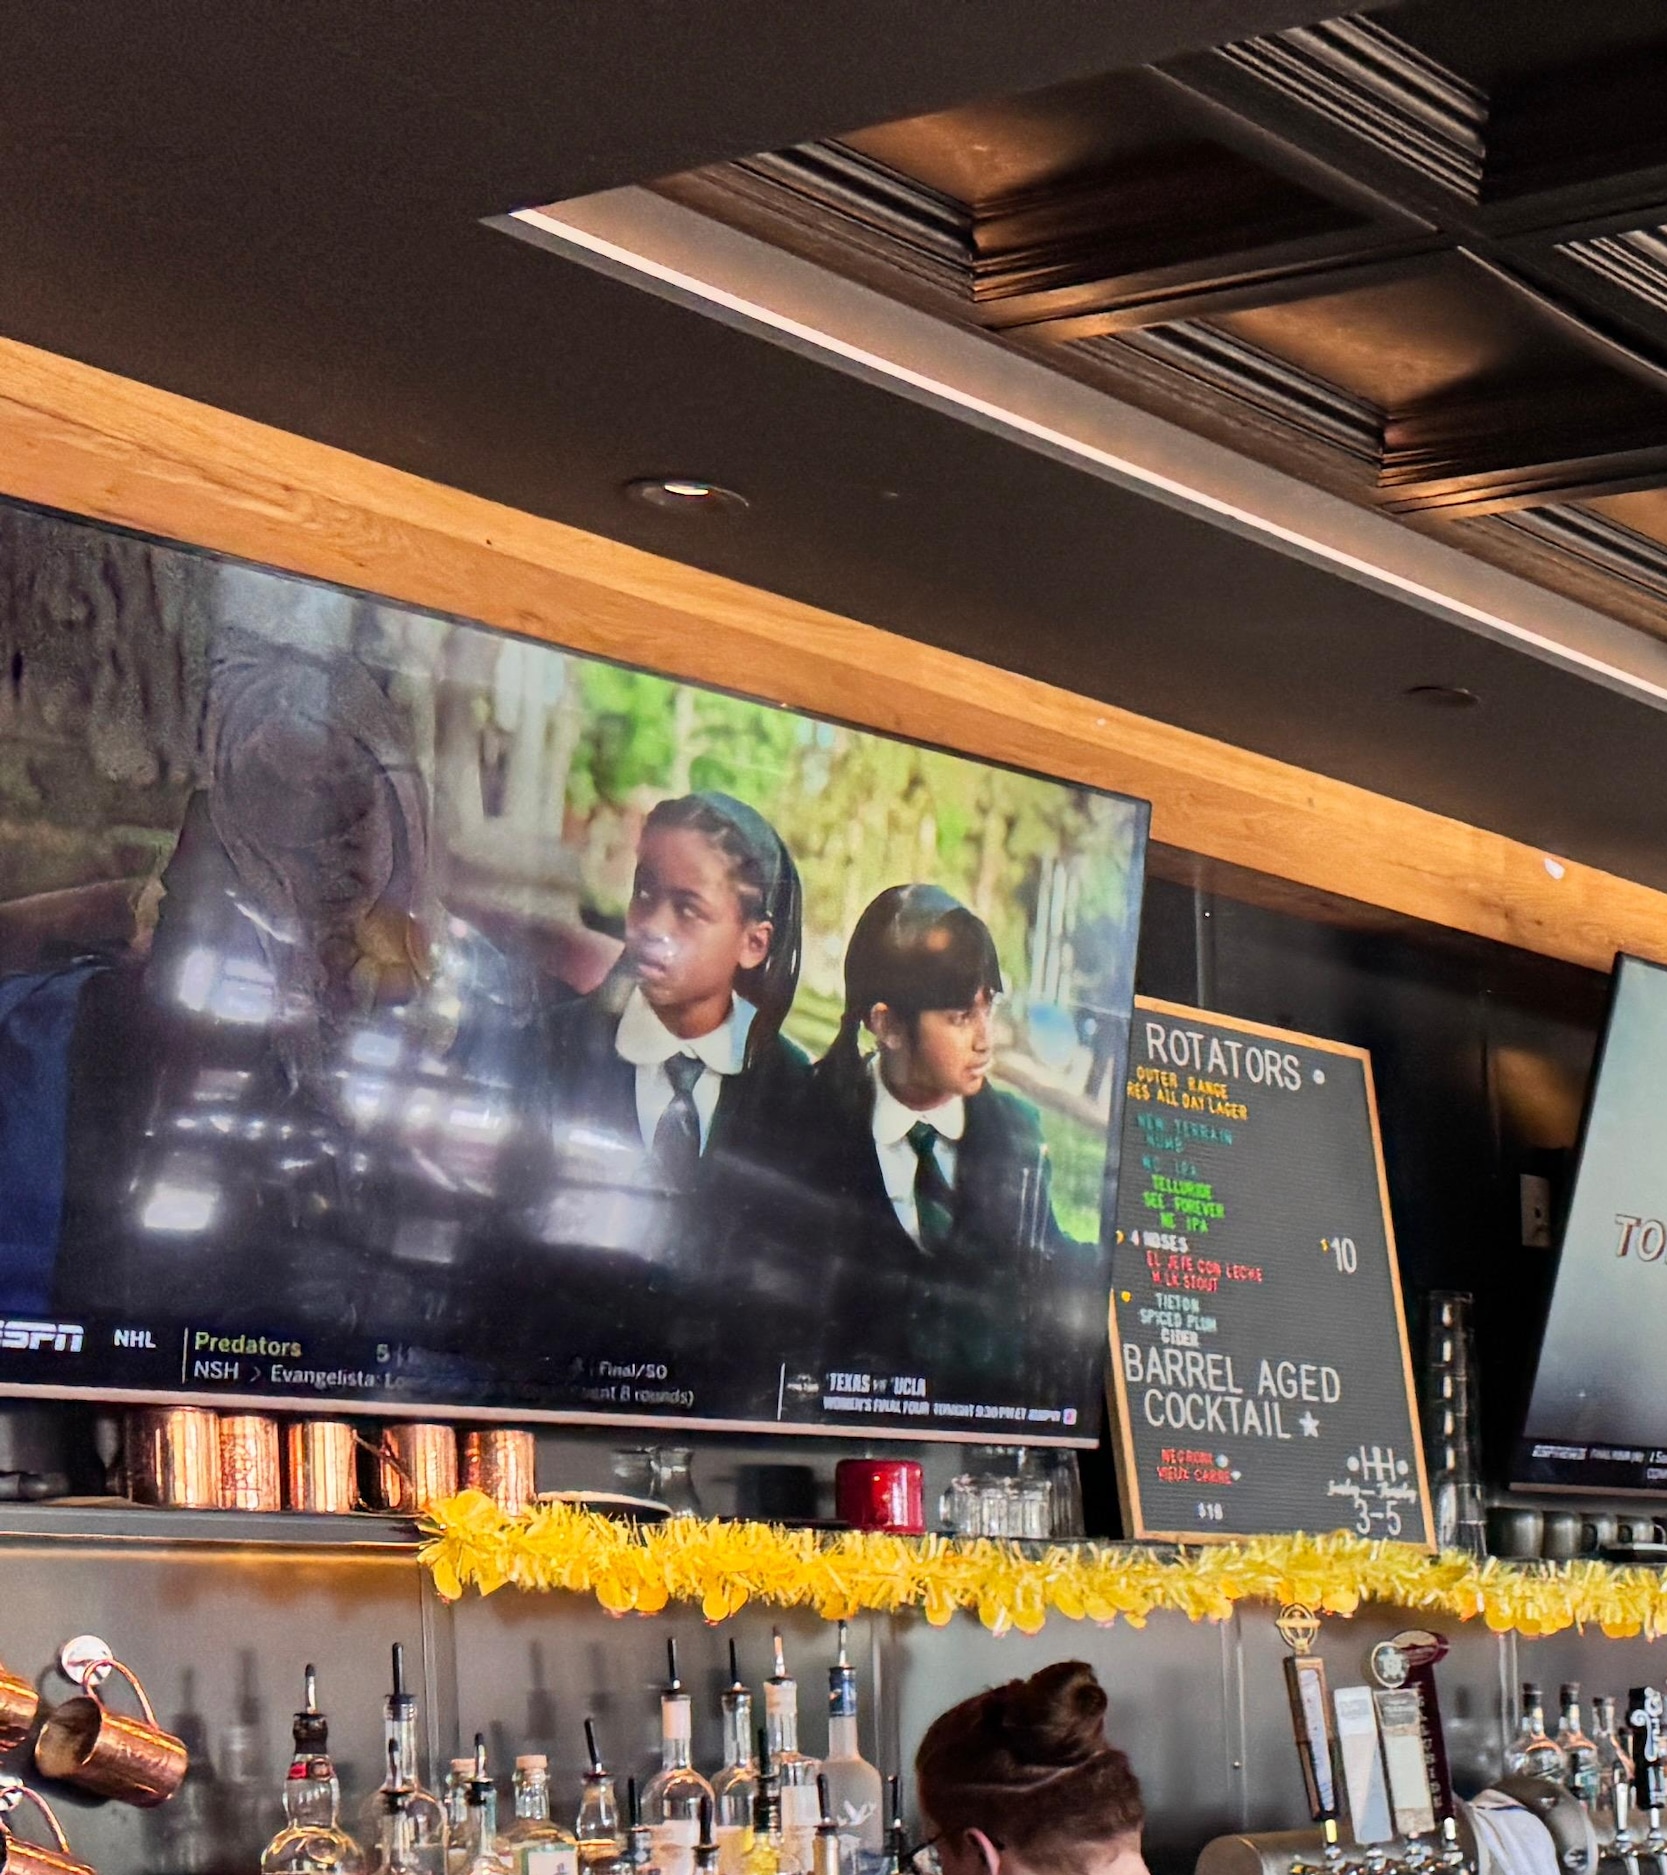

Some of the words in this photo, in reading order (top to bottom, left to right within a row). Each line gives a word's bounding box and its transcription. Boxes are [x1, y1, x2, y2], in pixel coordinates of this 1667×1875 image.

[1145, 1022, 1302, 1091] ROTATORS
[1136, 1065, 1178, 1089] OUTER
[1187, 1076, 1229, 1100] RANGE
[1157, 1087, 1180, 1107] ALL
[1181, 1092, 1206, 1112] DAY
[1207, 1097, 1249, 1121] LAGER
[1186, 1215, 1209, 1233] IPA
[1142, 1230, 1189, 1253] NOSES
[1225, 1262, 1264, 1284] LECHE
[1139, 1307, 1183, 1329] SPICED
[0, 1319, 84, 1353] SPN
[113, 1328, 157, 1349] NHL
[194, 1330, 303, 1358] Predators
[375, 1343, 391, 1364] 5
[1160, 1327, 1200, 1347] CIDER
[193, 1360, 240, 1380] NSH
[829, 1372, 871, 1393] TEXAS
[893, 1375, 927, 1398] UCLA
[1122, 1342, 1244, 1395] BARREL
[1257, 1358, 1341, 1404] AGED
[1143, 1387, 1293, 1440] COCKTAIL
[1354, 1497, 1402, 1537] 3-5
